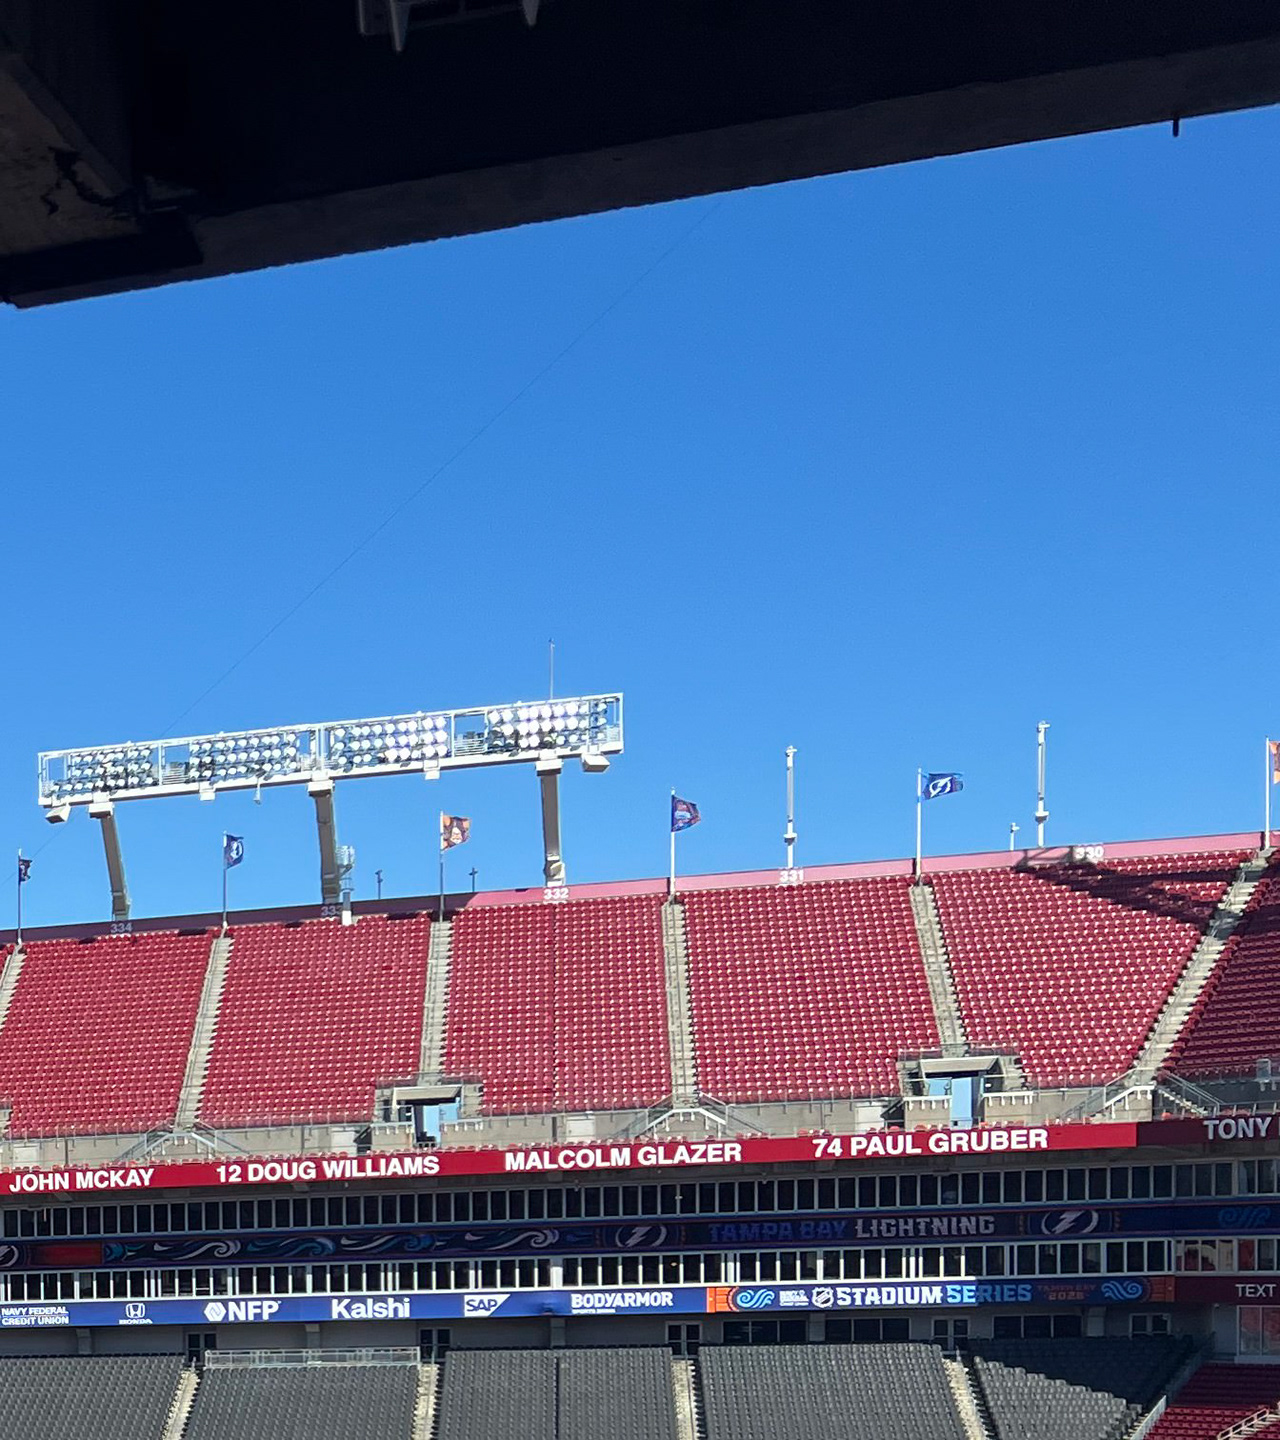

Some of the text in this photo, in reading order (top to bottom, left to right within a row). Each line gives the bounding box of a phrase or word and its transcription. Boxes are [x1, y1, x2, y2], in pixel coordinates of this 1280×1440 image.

[780, 870, 804, 882] 331
[543, 888, 569, 900] 332
[1203, 1117, 1271, 1140] TONY
[812, 1129, 1048, 1157] 74 PAUL GRUBER
[505, 1143, 741, 1171] MALCOLM GLAZER
[9, 1168, 154, 1193] JOHN MCKAY
[216, 1156, 440, 1183] 12 DOUG WILLIAMS
[709, 1215, 995, 1242] TAMPA BAY LIGHTNING
[466, 1299, 497, 1312] SAP
[571, 1292, 674, 1308] BODYARMOR
[837, 1286, 941, 1307] STADIUM
[946, 1284, 1032, 1303] SERIES
[1, 1306, 69, 1317] NAVY FEDERAL
[228, 1301, 279, 1321] NFP
[332, 1297, 410, 1319] Kalshi
[2, 1316, 69, 1326] CREDIT UNION
